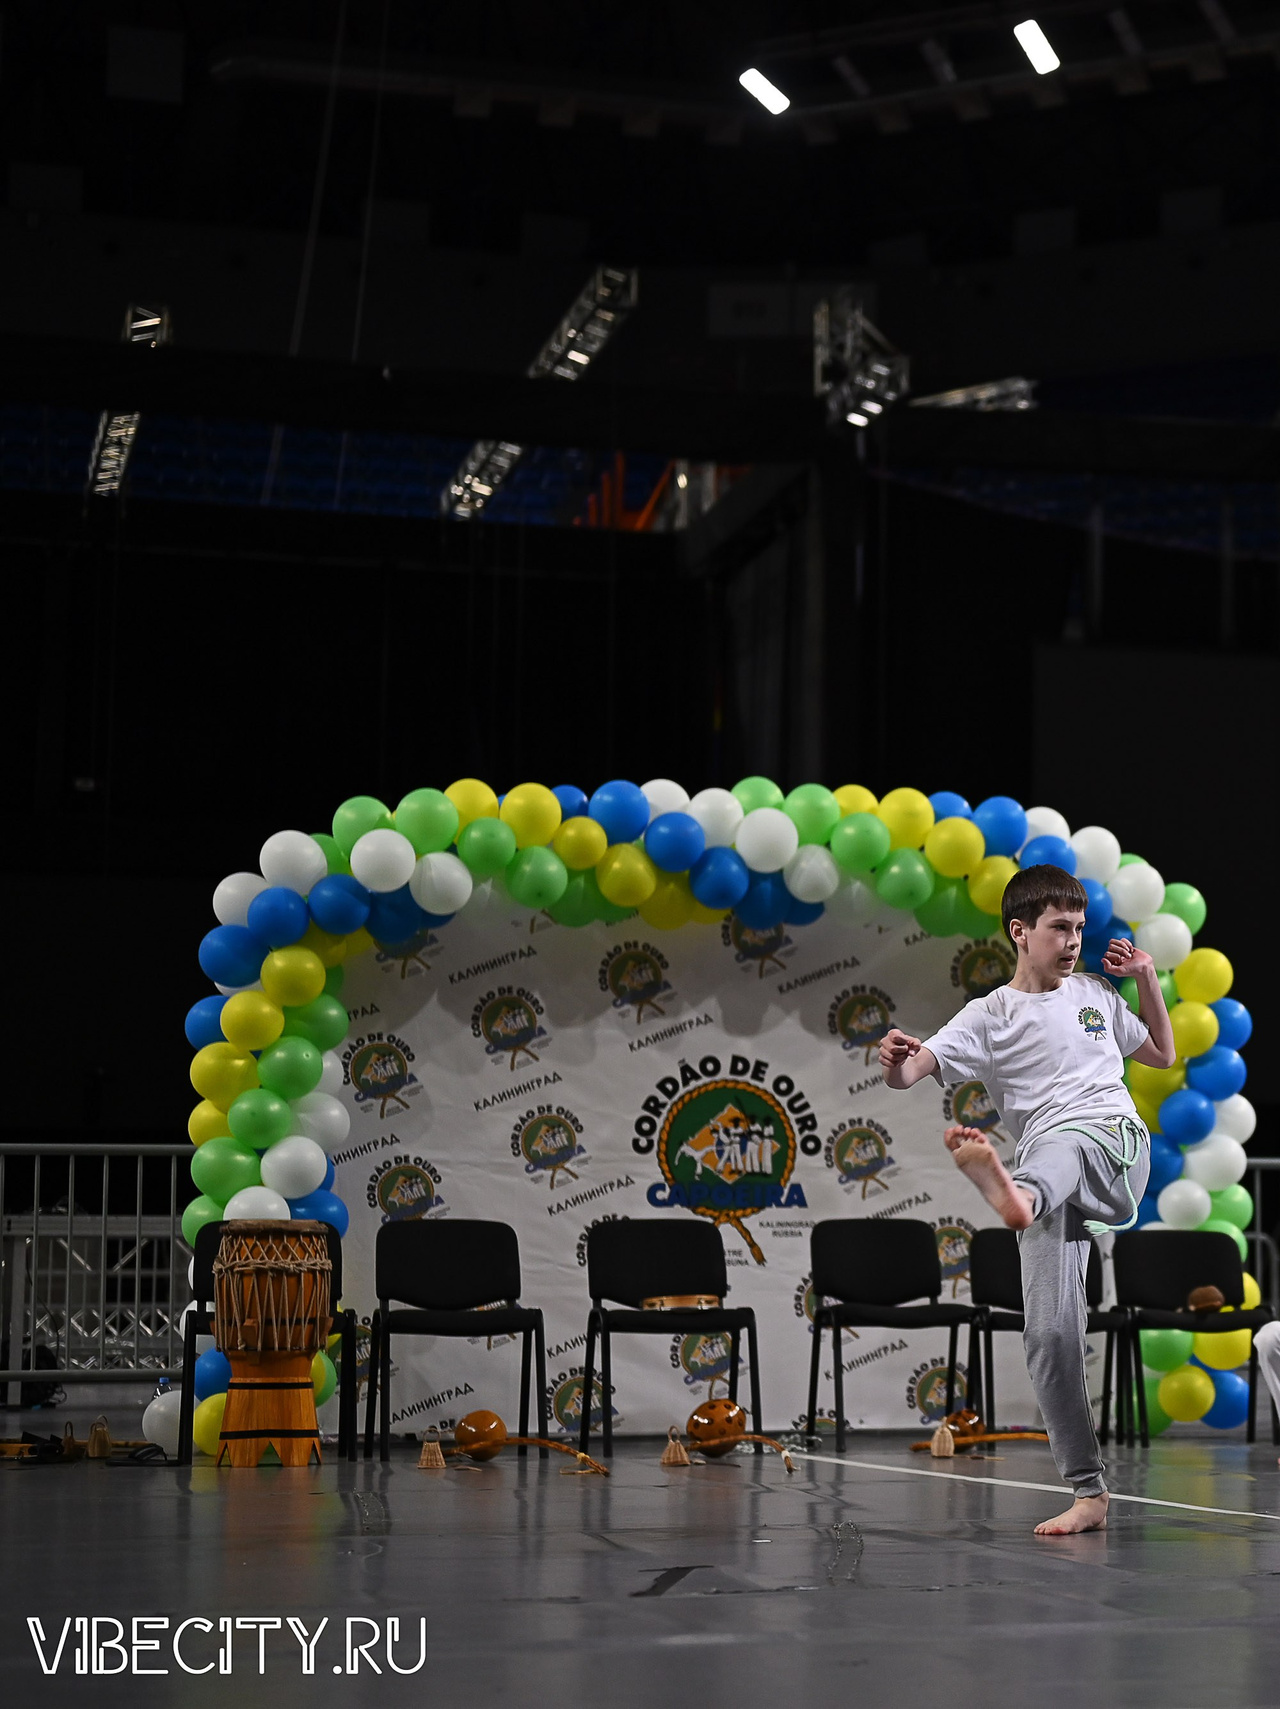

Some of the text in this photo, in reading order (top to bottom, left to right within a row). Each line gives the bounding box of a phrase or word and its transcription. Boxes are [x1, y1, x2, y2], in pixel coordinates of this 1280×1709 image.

[624, 940, 638, 949] DE
[448, 945, 537, 984] КАЛИНИНГРАД
[497, 986, 513, 995] DE
[516, 987, 544, 1015] OURO
[852, 984, 866, 993] DE
[368, 1032, 383, 1042] DE
[386, 1034, 415, 1062] OURO
[628, 1013, 713, 1052] КАЛИНИНГРАД
[474, 1071, 562, 1111] КАЛИНИНГРАД
[632, 1054, 822, 1156] CORDÃO DE OURO
[537, 1104, 552, 1114] DE
[556, 1106, 583, 1133] OURO
[848, 1118, 862, 1127] DE
[331, 1133, 400, 1166] ИНИНГРАД
[394, 1155, 410, 1165] DE
[413, 1157, 442, 1184] OURO
[547, 1175, 635, 1216] КАЛИНИНГРАД
[647, 1183, 808, 1208] CAPOEIRA
[388, 1382, 474, 1425] АЛИНИНГРАД
